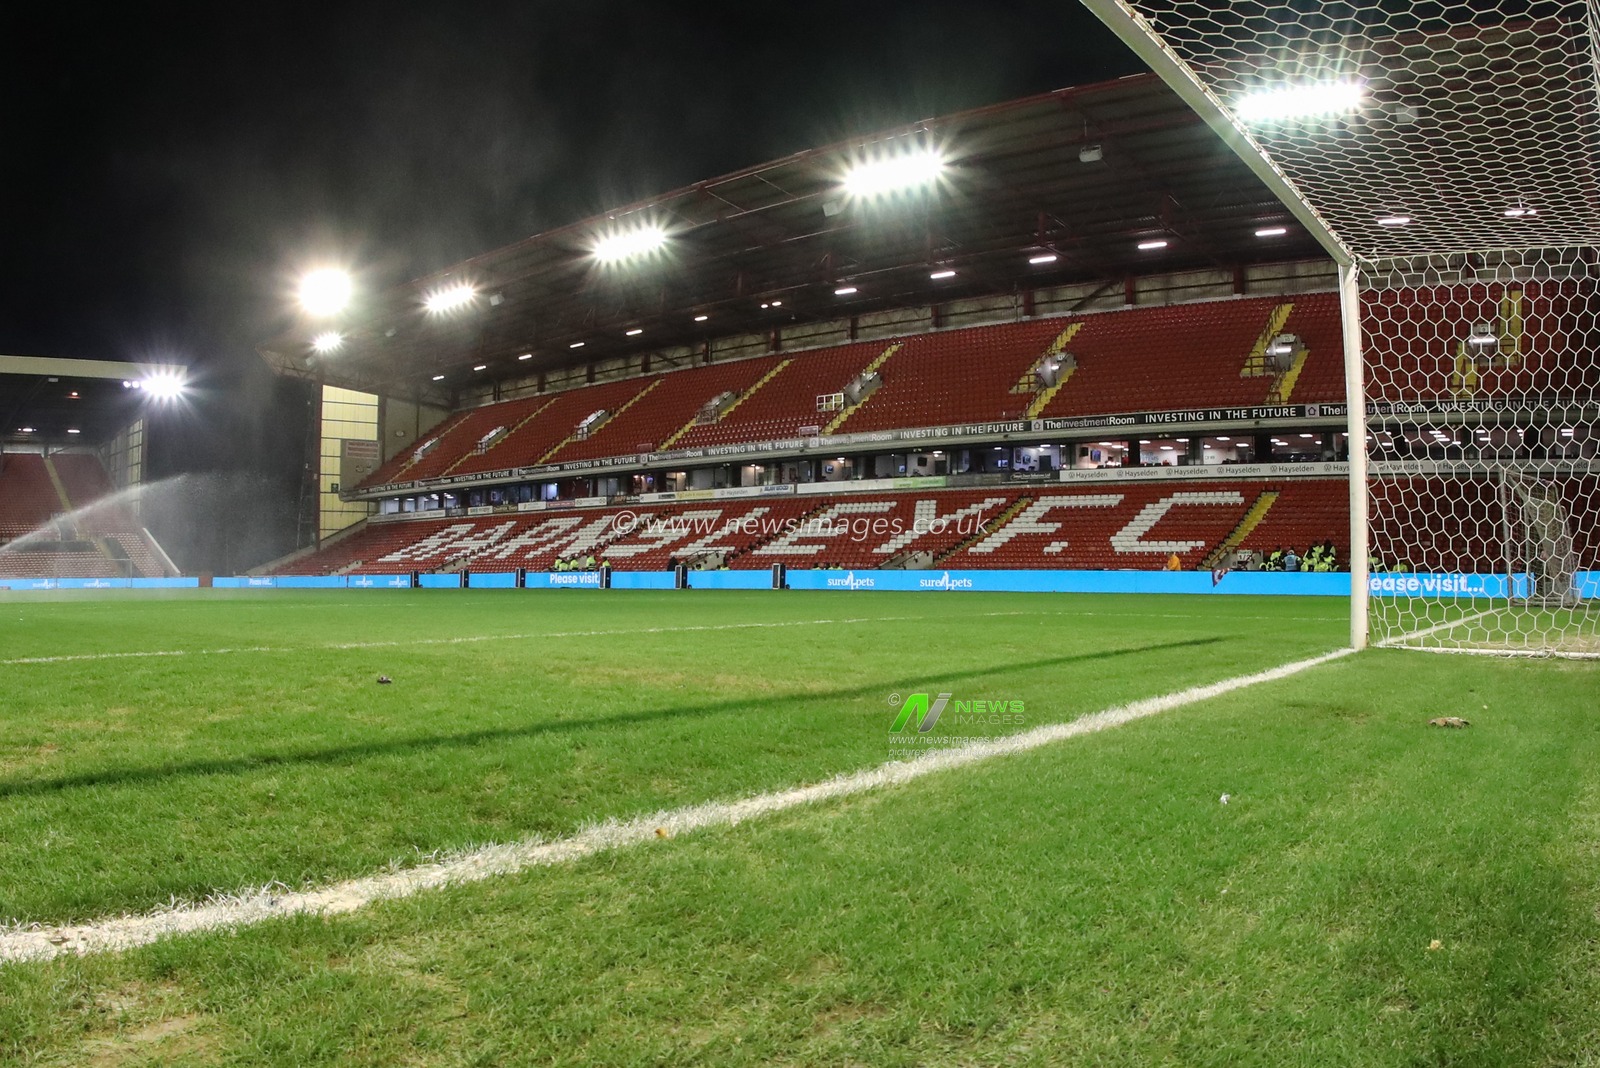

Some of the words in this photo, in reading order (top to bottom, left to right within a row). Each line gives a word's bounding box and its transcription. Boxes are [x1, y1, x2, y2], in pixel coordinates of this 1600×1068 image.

[1045, 416, 1135, 429] TheInvestmentRoom
[1146, 412, 1204, 423] INVESTING
[1209, 411, 1221, 420] IN
[1226, 409, 1248, 419] THE
[1252, 407, 1297, 418] FUTURE
[900, 428, 948, 439] INVESTING
[951, 427, 962, 436] IN
[966, 425, 983, 434] THE
[987, 422, 1024, 432] FUTURE
[708, 445, 746, 456] INVESTING
[747, 444, 756, 452] IN
[759, 442, 773, 451] THE
[775, 440, 804, 450] FUTURE
[563, 461, 592, 470] INVESTING
[593, 460, 600, 468] IN
[601, 458, 613, 466] THE
[614, 456, 637, 465] FUTURE
[1076, 471, 1108, 479] Hayselden
[1124, 470, 1158, 478] Hayselden
[1173, 468, 1209, 476] Hayselden
[1225, 466, 1261, 474] Hayselden
[1278, 465, 1315, 473] Hayselden
[549, 573, 578, 584] Please
